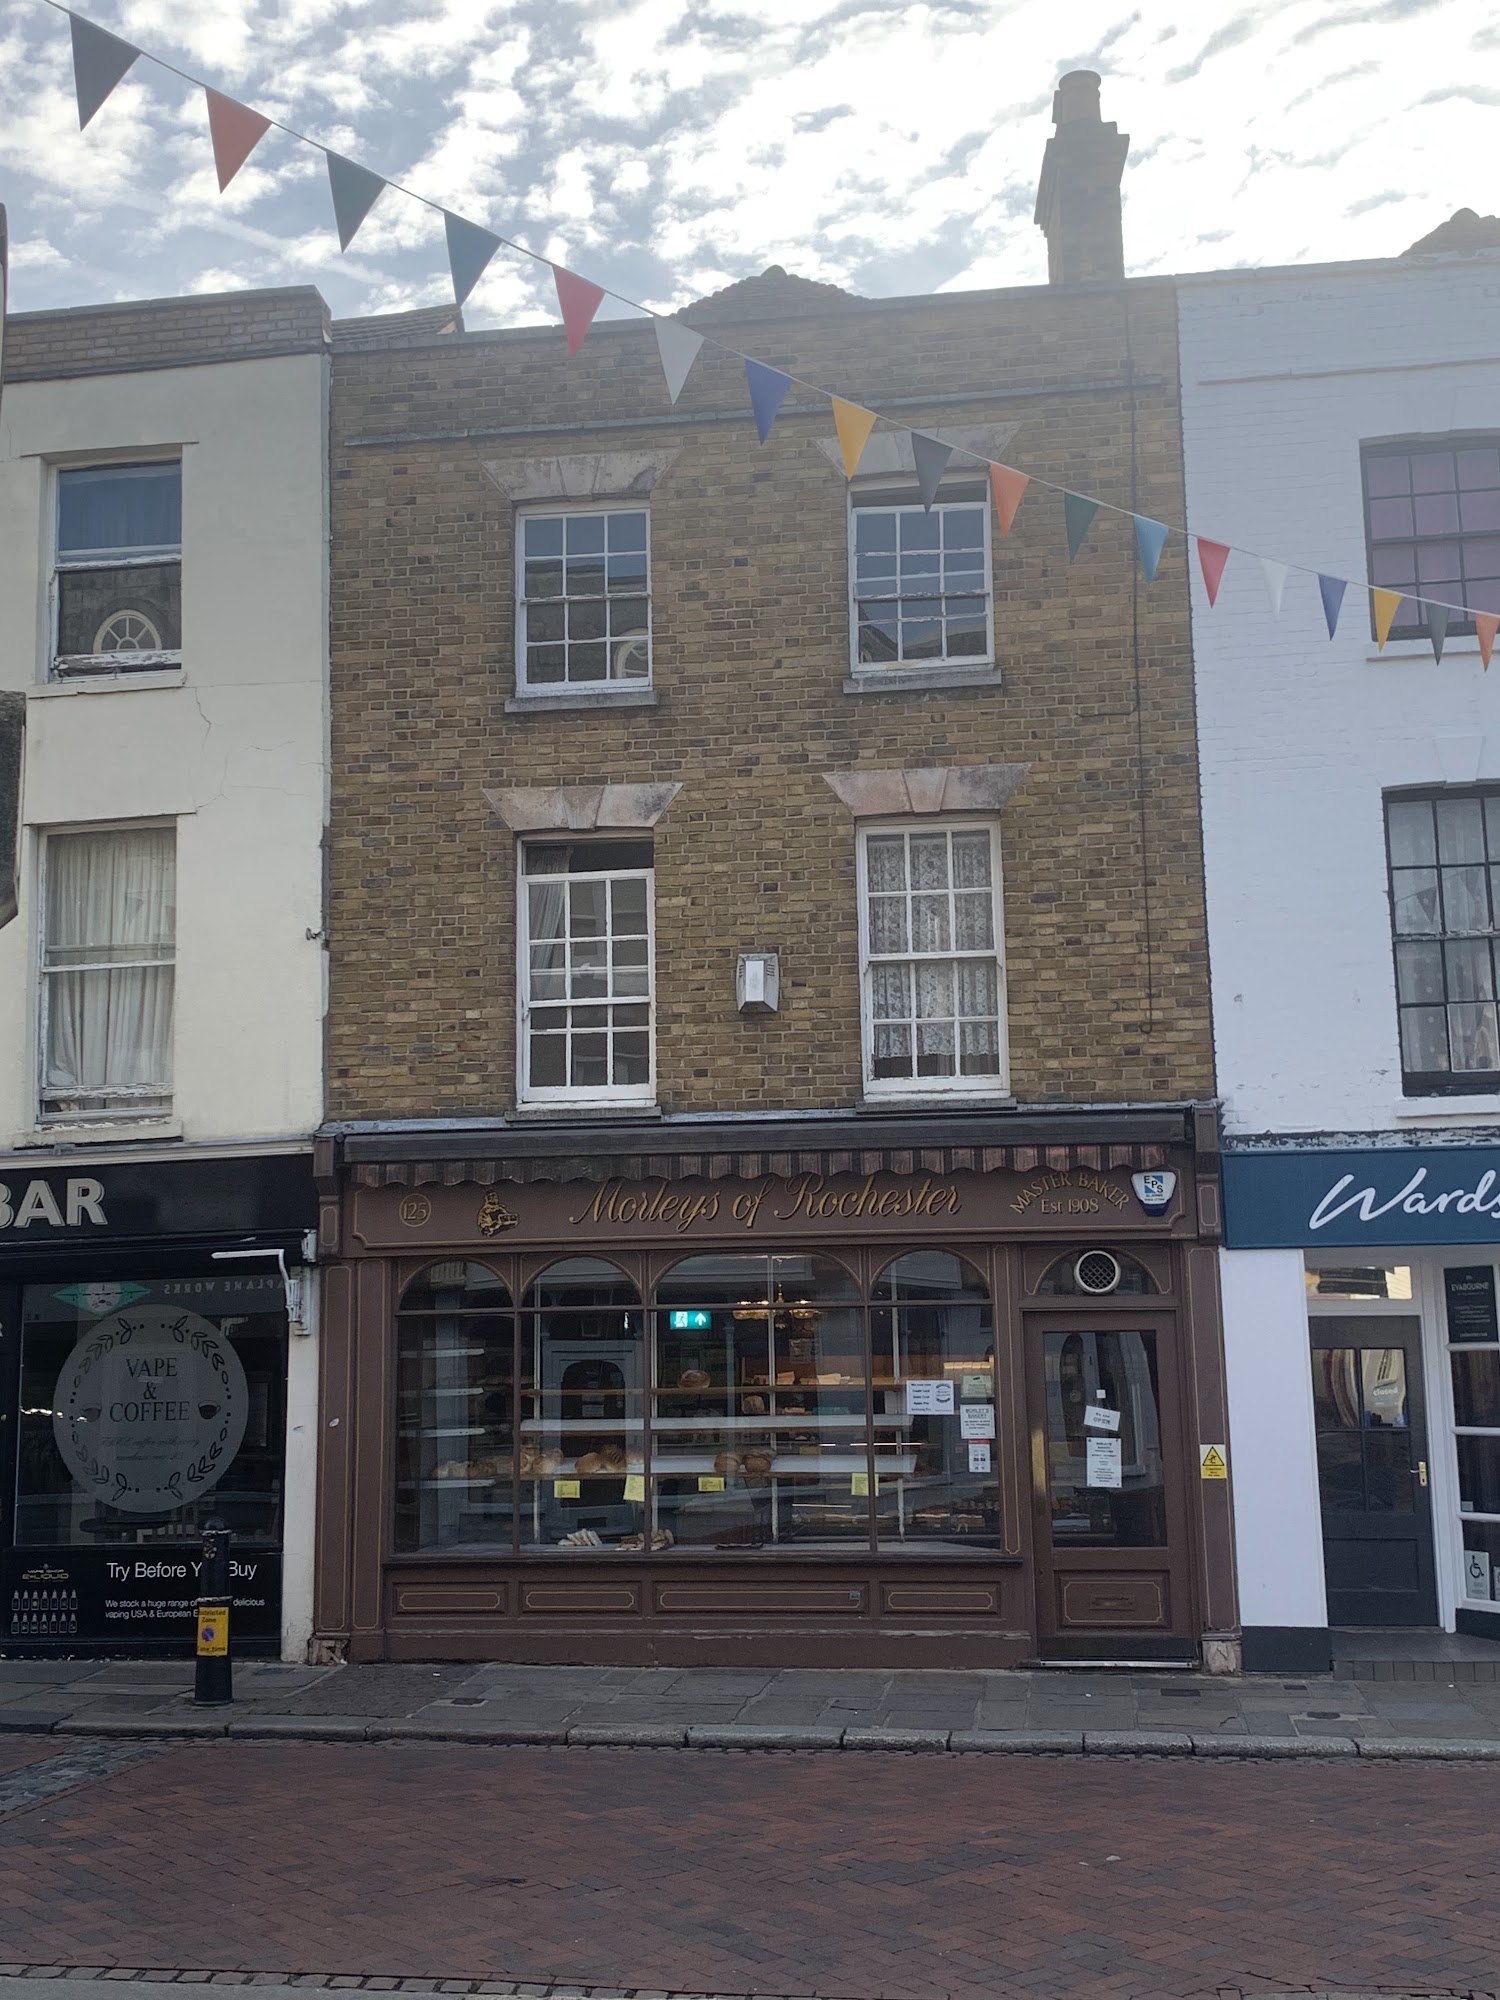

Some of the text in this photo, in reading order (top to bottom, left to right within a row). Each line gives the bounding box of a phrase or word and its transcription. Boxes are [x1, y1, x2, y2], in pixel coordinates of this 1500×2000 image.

[1010, 1171, 1130, 1214] MASTER BAKER
[1143, 1175, 1164, 1194] EPS
[403, 1202, 427, 1220] 125
[568, 1174, 962, 1232] Morleys of Rochester
[1041, 1197, 1100, 1213] Est 1908
[126, 1357, 177, 1378] VAPE
[143, 1381, 157, 1400] &
[109, 1401, 190, 1423] COFFEE
[106, 1562, 130, 1582] Try
[135, 1562, 187, 1578] Before
[229, 1560, 257, 1580] Buy
[120, 1599, 139, 1607] stock
[148, 1599, 166, 1609] huge
[168, 1600, 188, 1609] range
[232, 1598, 265, 1607] delicious
[105, 1611, 130, 1619] vaping
[131, 1610, 148, 1618] USA
[149, 1610, 155, 1618] &
[157, 1610, 191, 1619] European
